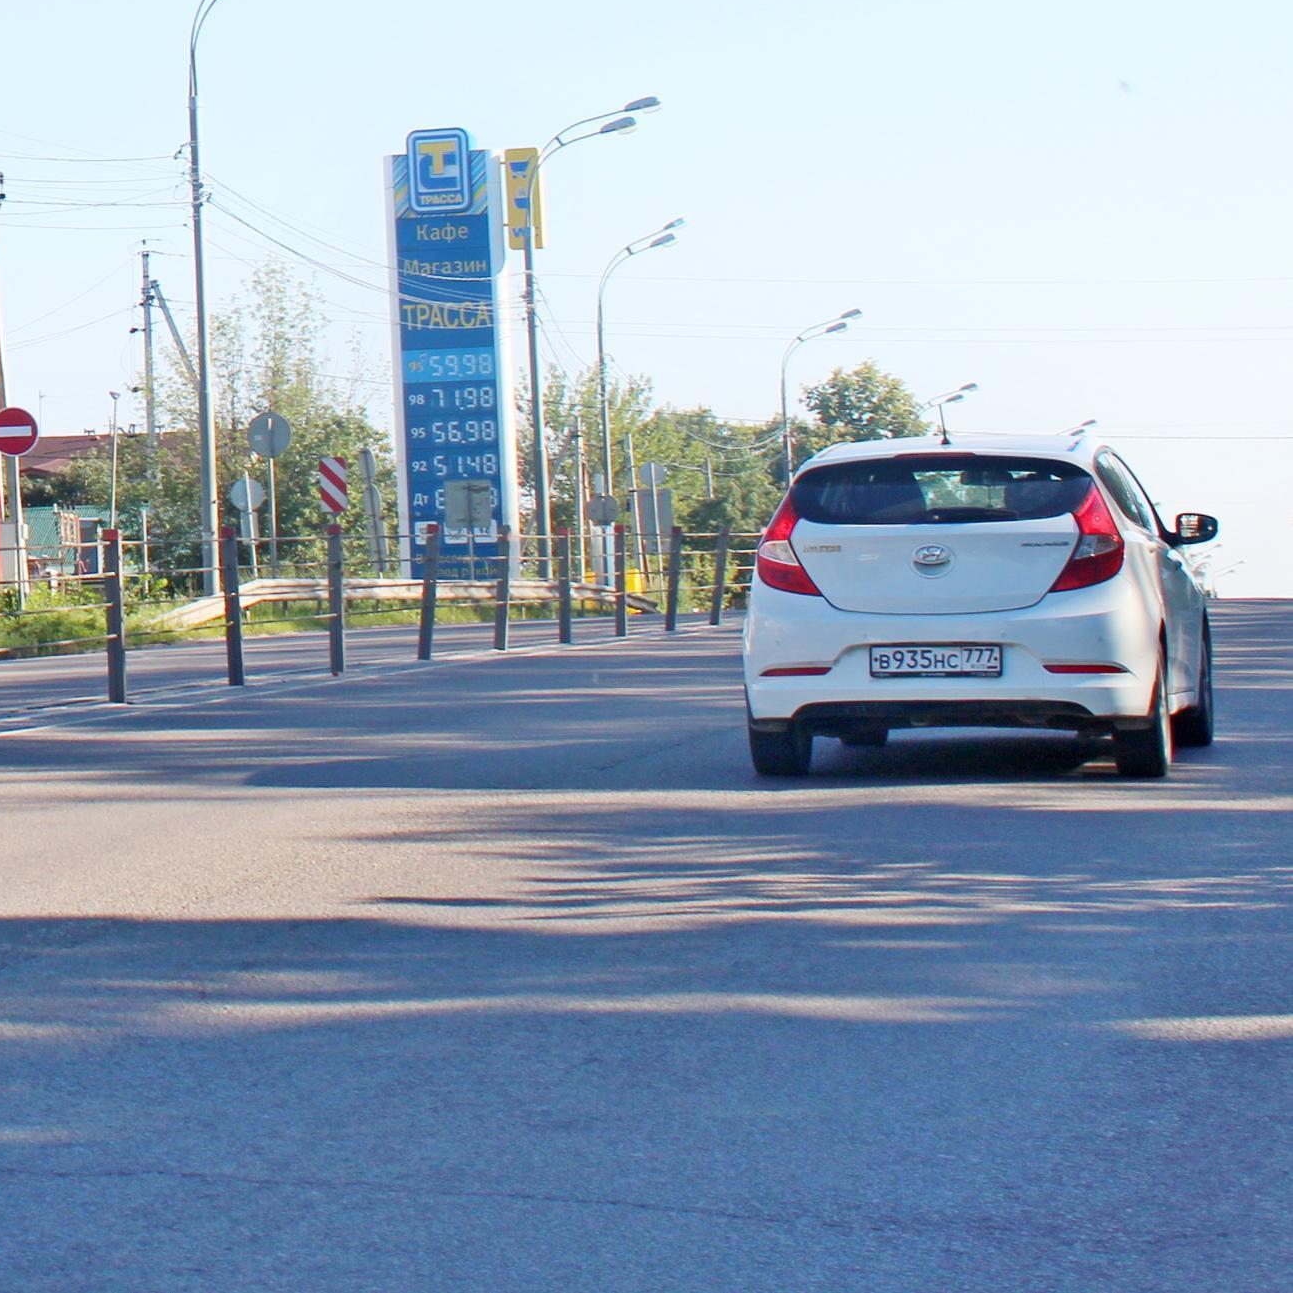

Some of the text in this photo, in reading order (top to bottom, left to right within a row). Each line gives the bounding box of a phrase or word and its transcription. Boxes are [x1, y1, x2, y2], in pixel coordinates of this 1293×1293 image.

[418, 193, 464, 206] ТРАССА
[416, 222, 469, 243] Кафе
[403, 259, 487, 276] Магазин
[402, 301, 492, 331] ТРАССА
[429, 353, 493, 377] 59.98
[408, 386, 495, 410] 98 71.98
[410, 419, 497, 443] 95 56.98
[411, 453, 497, 477] 92 51.48
[963, 648, 995, 663] 777
